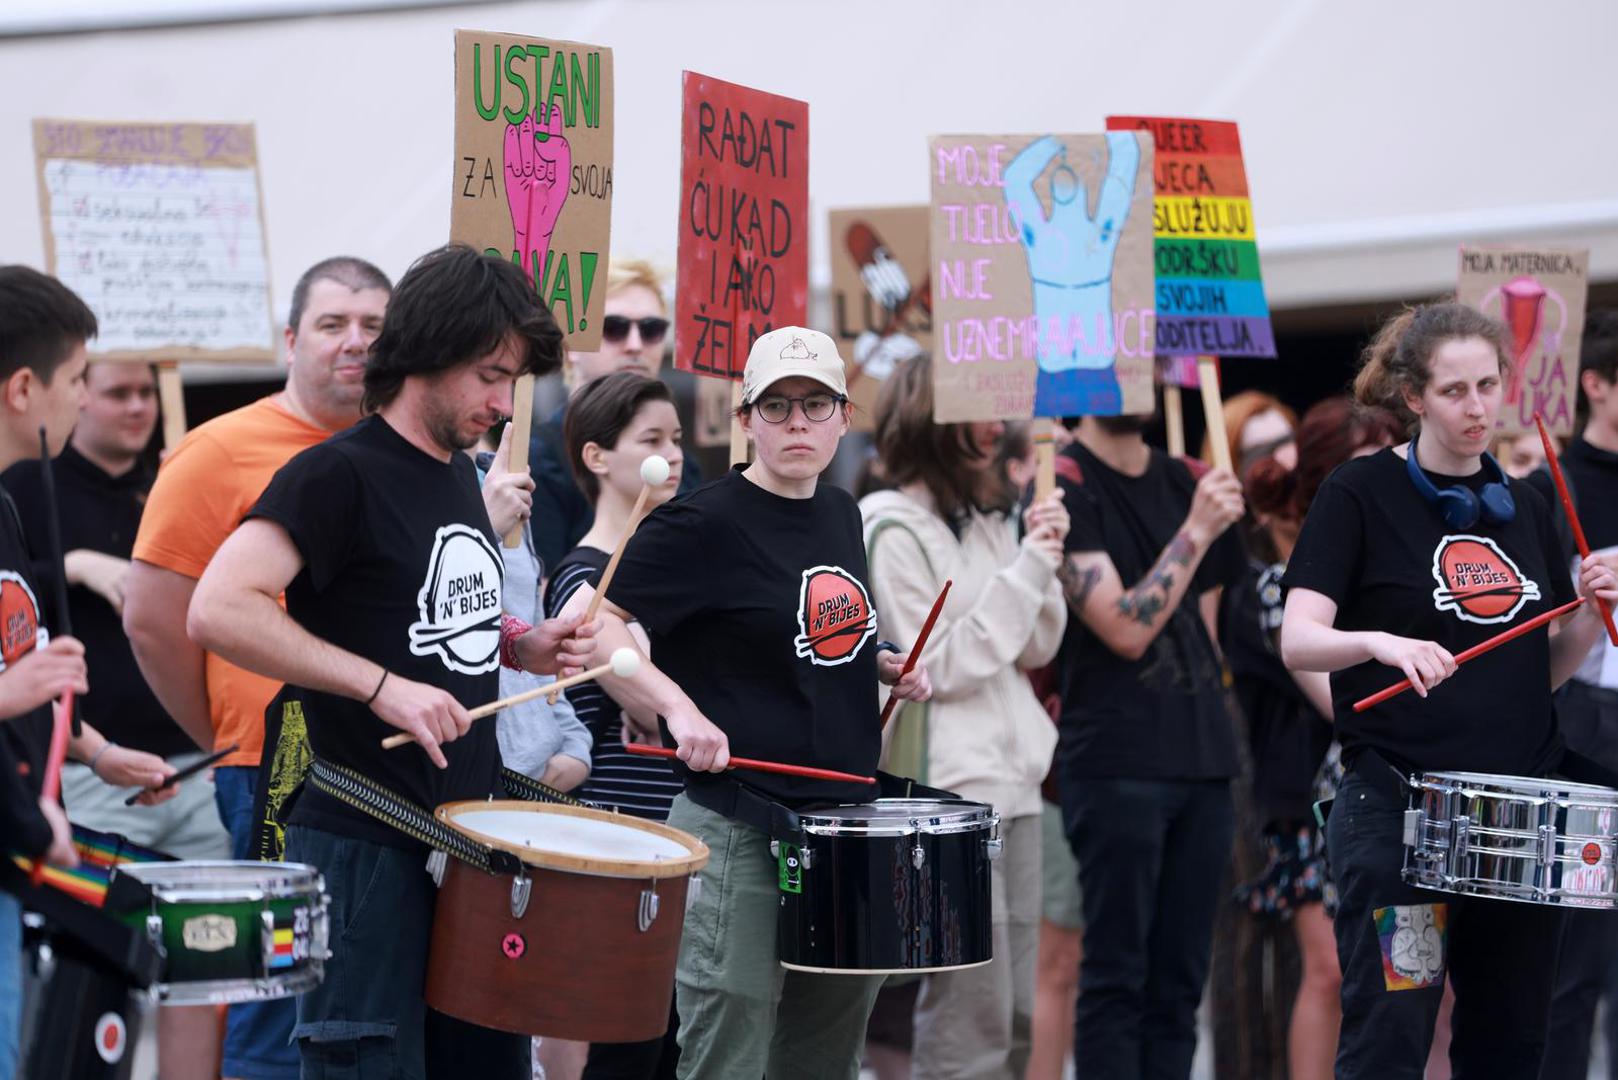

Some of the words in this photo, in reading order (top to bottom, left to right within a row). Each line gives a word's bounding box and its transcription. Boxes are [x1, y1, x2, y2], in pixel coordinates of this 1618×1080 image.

[474, 43, 600, 128] USTANI
[699, 101, 795, 178] RAĐAT
[463, 157, 497, 198] ZA
[571, 163, 613, 201] SVOJA
[936, 144, 1008, 188] MOJE
[1155, 162, 1215, 193] JECA
[690, 168, 724, 241] ĆU
[731, 187, 792, 259] KAD
[940, 201, 1024, 245] TIJELO
[1154, 197, 1248, 234] SLUŽUJU
[1156, 240, 1239, 276] ODRŠKU
[1463, 252, 1494, 274] MOJA
[483, 247, 599, 335] VA!
[940, 258, 993, 300] NIJE
[1157, 282, 1229, 314] SVOJIH
[943, 299, 1156, 364] UZNEMIRAVAJUĆE
[1156, 318, 1255, 352] ODITELJA
[1496, 391, 1571, 428] UKA
[448, 571, 484, 598] DRUM
[1455, 562, 1492, 575] DRUM
[1472, 572, 1509, 585] BIJES
[440, 600, 457, 620] 'N'
[460, 588, 497, 617] BIJES
[818, 592, 851, 617] DRUM
[828, 603, 861, 628] BIJES
